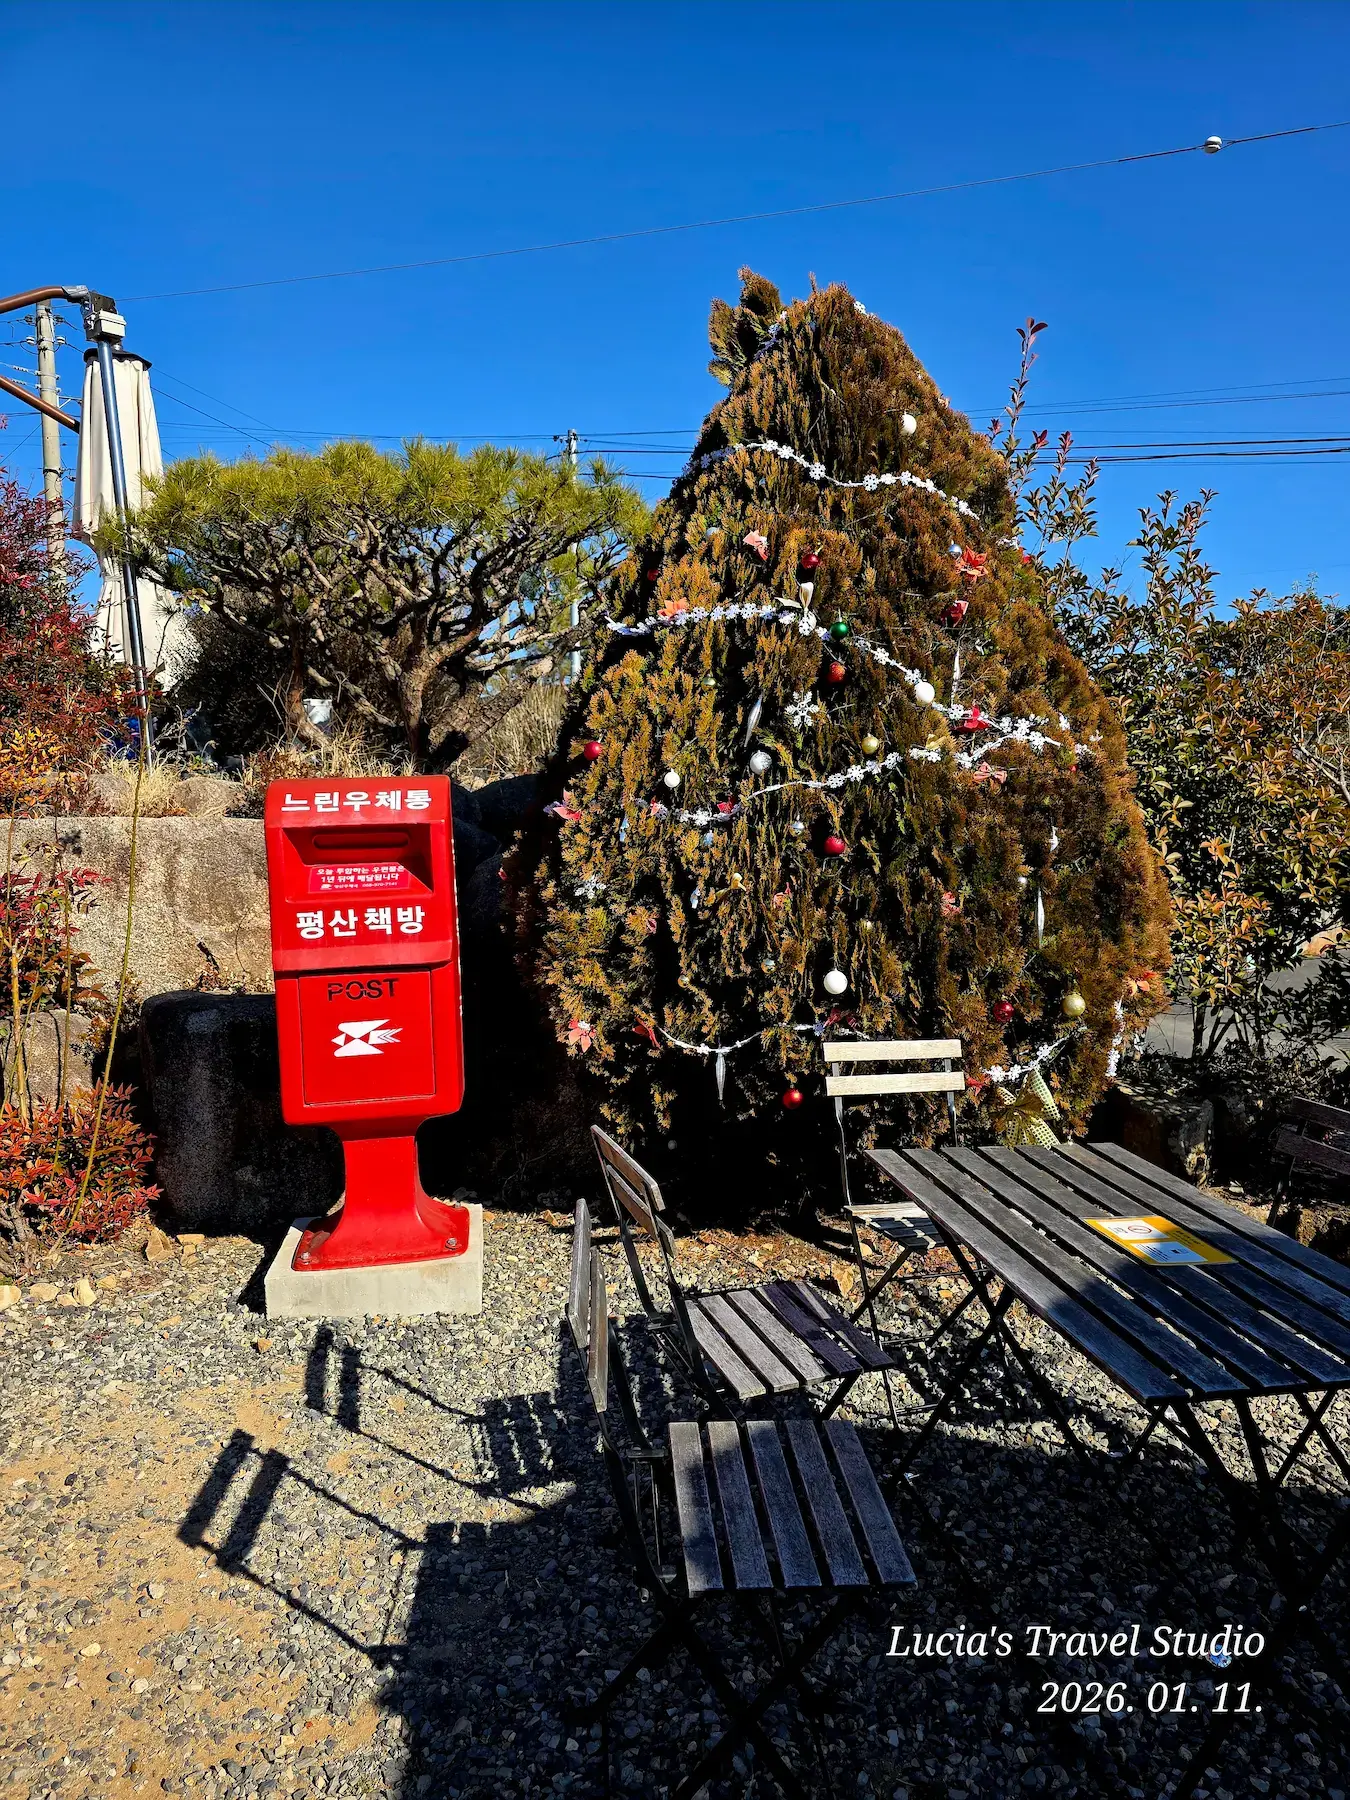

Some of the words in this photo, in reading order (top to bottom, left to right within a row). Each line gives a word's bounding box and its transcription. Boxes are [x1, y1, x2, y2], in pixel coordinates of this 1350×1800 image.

[281, 789, 432, 813] 느린우체통
[372, 865, 405, 873] 우편물은
[321, 875, 335, 883] 1년
[337, 875, 355, 883] 뒤에
[357, 873, 400, 882] 배달됩니다
[327, 977, 399, 1002] POST
